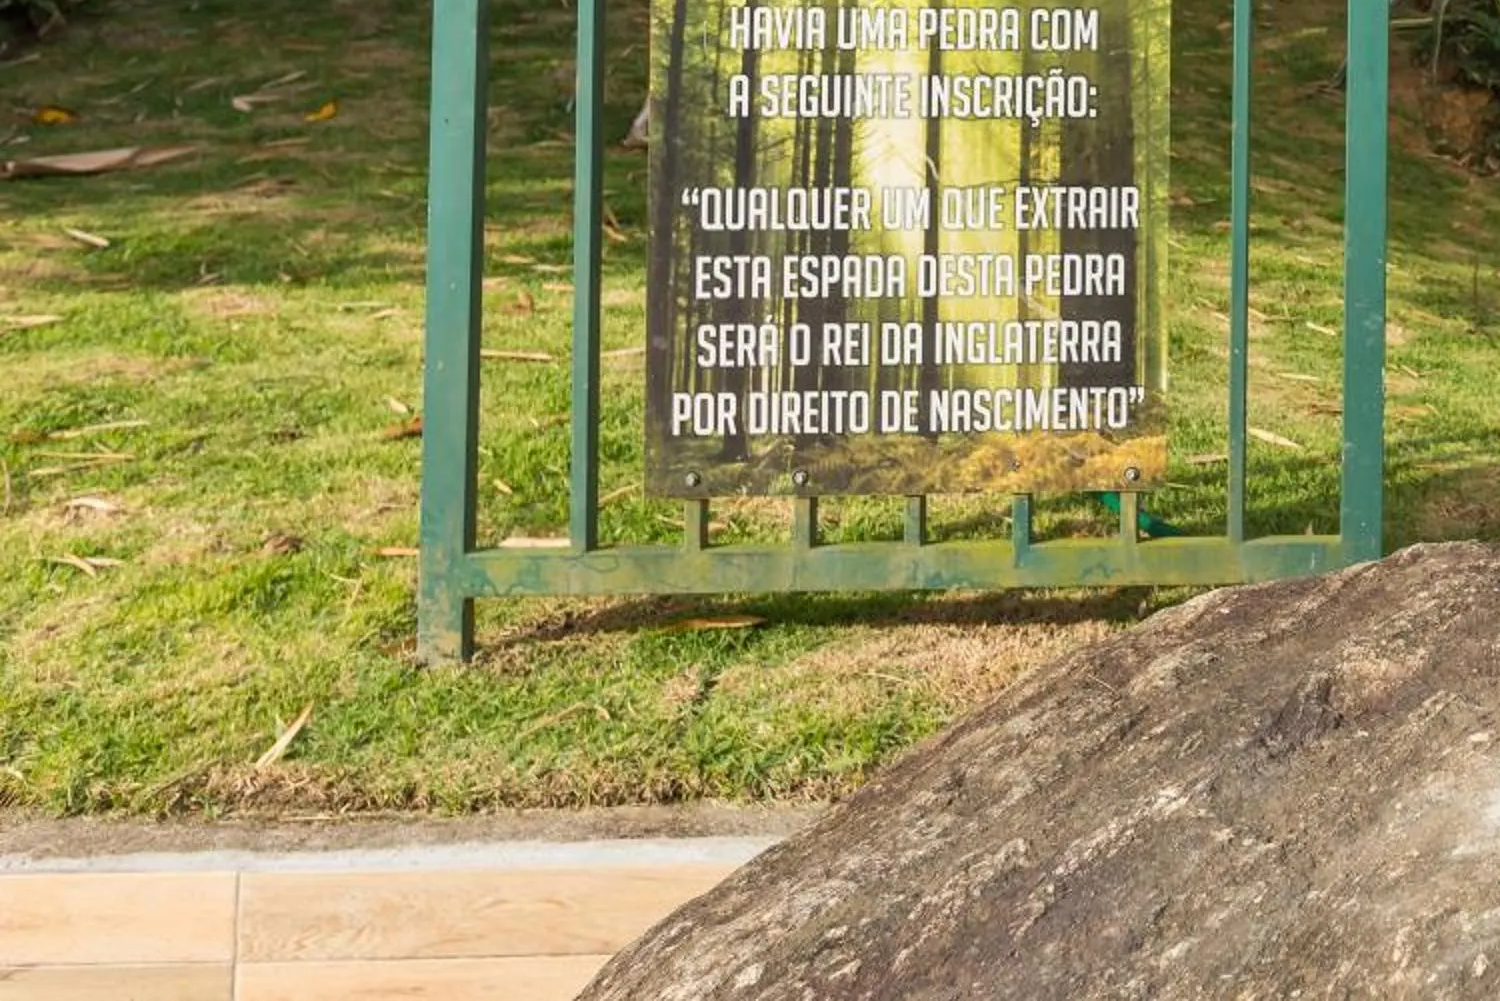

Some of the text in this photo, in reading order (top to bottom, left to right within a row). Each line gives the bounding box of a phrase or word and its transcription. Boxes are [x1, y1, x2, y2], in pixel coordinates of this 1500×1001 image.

[730, 7, 1099, 51] HAVIA UMA PEDRA COM
[728, 69, 1098, 127] A SEGUINTE INSCRIÇÃO:
[883, 187, 932, 230] UM
[942, 187, 1003, 230] QUE
[1015, 187, 1140, 229] EXTRAIR
[695, 254, 1126, 300] ESTA ESPADA DESTA PEDRA
[697, 314, 1122, 367] SERÁ O REI DA INGLATERRA
[671, 392, 737, 436] POR
[748, 391, 870, 435] DIREITO
[881, 391, 919, 433] DE
